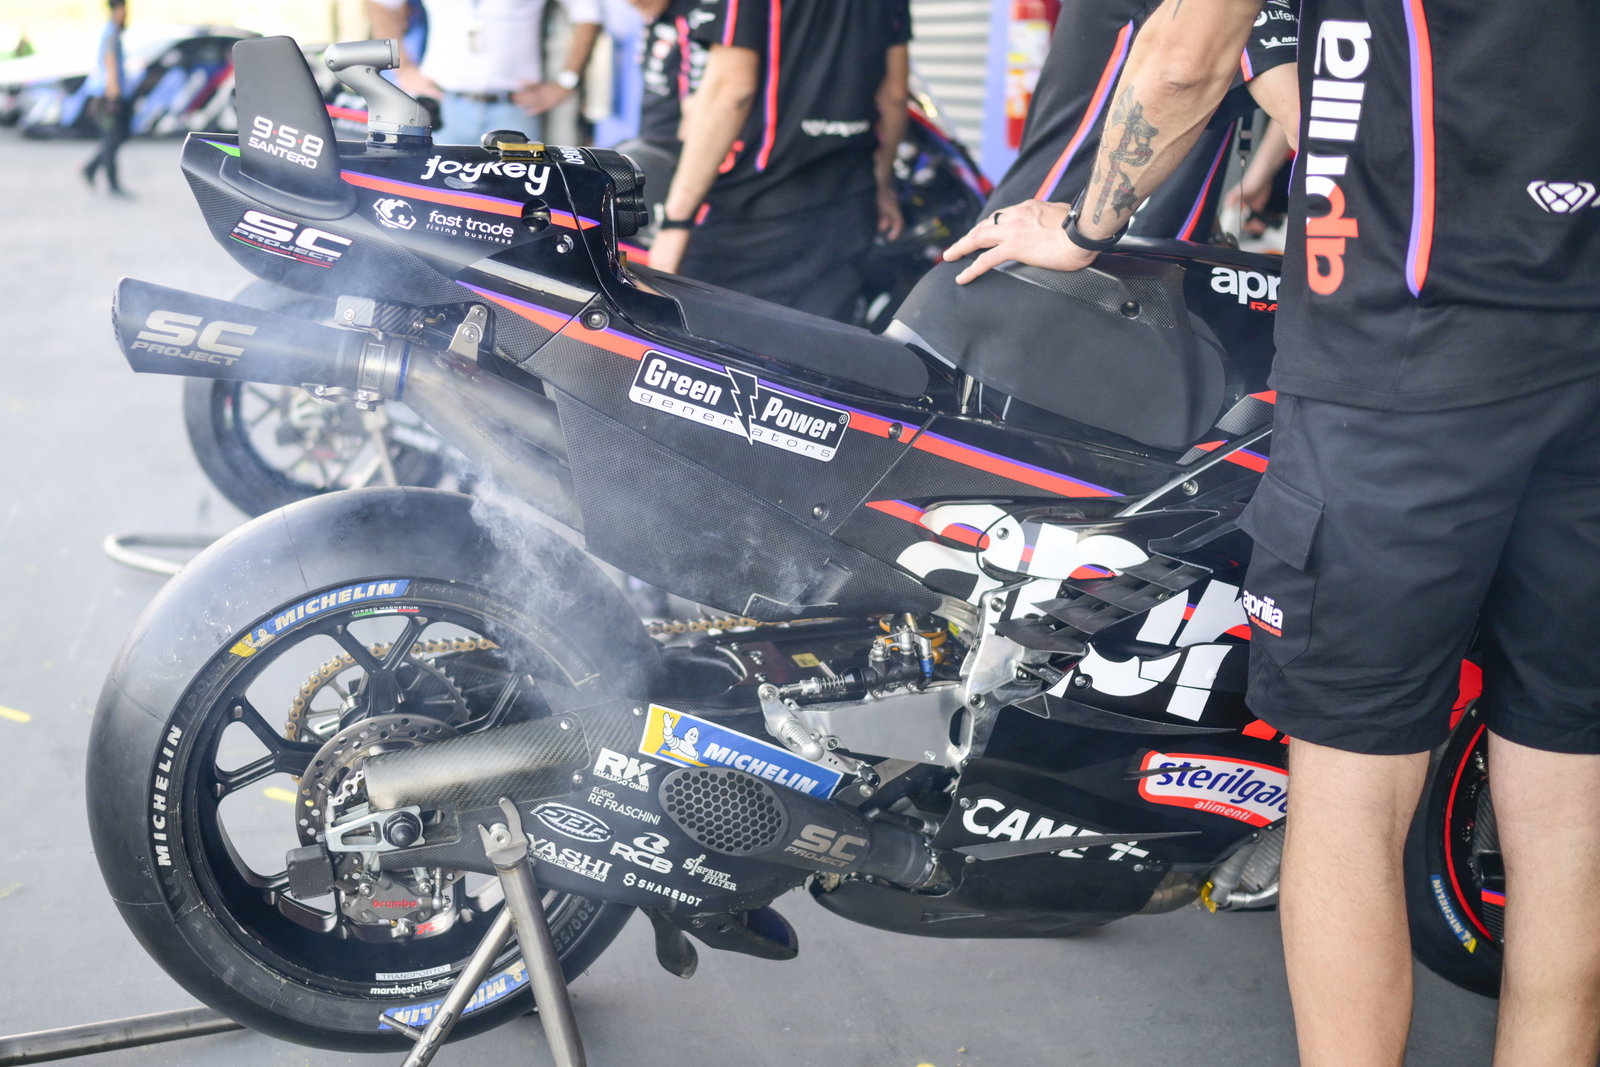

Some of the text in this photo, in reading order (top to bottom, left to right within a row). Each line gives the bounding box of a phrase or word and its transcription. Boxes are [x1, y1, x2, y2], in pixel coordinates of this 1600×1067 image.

[248, 138, 318, 169] SANTERO
[237, 210, 353, 258] SC
[426, 223, 512, 245] fixing business
[429, 210, 515, 238] fast trade
[232, 227, 339, 262] PROJECT
[1210, 266, 1281, 305] apr
[136, 309, 258, 356] SC
[131, 340, 240, 367] PROJECT
[643, 358, 837, 441] Green Power
[274, 581, 398, 633] MICHELIN
[1242, 589, 1284, 630] aprilia
[594, 747, 657, 789] RK
[703, 742, 820, 794] MICHELIN
[152, 724, 183, 867] MICHELIN
[592, 786, 615, 799] ELIGIO
[1156, 761, 1288, 814] sterilgar
[603, 798, 661, 826] FRASCHINI
[1193, 801, 1254, 821] alimenti
[526, 832, 613, 876] YASHI
[610, 841, 673, 874] RCB
[783, 845, 850, 868] PROJECT
[793, 823, 868, 862] SC
[532, 850, 607, 883] OMPUTER
[696, 865, 731, 881] SPRINT
[637, 878, 703, 908] SHAREBOT
[702, 875, 737, 892] FILTER
[372, 899, 418, 909] brembo
[1432, 879, 1464, 934] MICHELIN
[370, 981, 423, 996] marchesini
